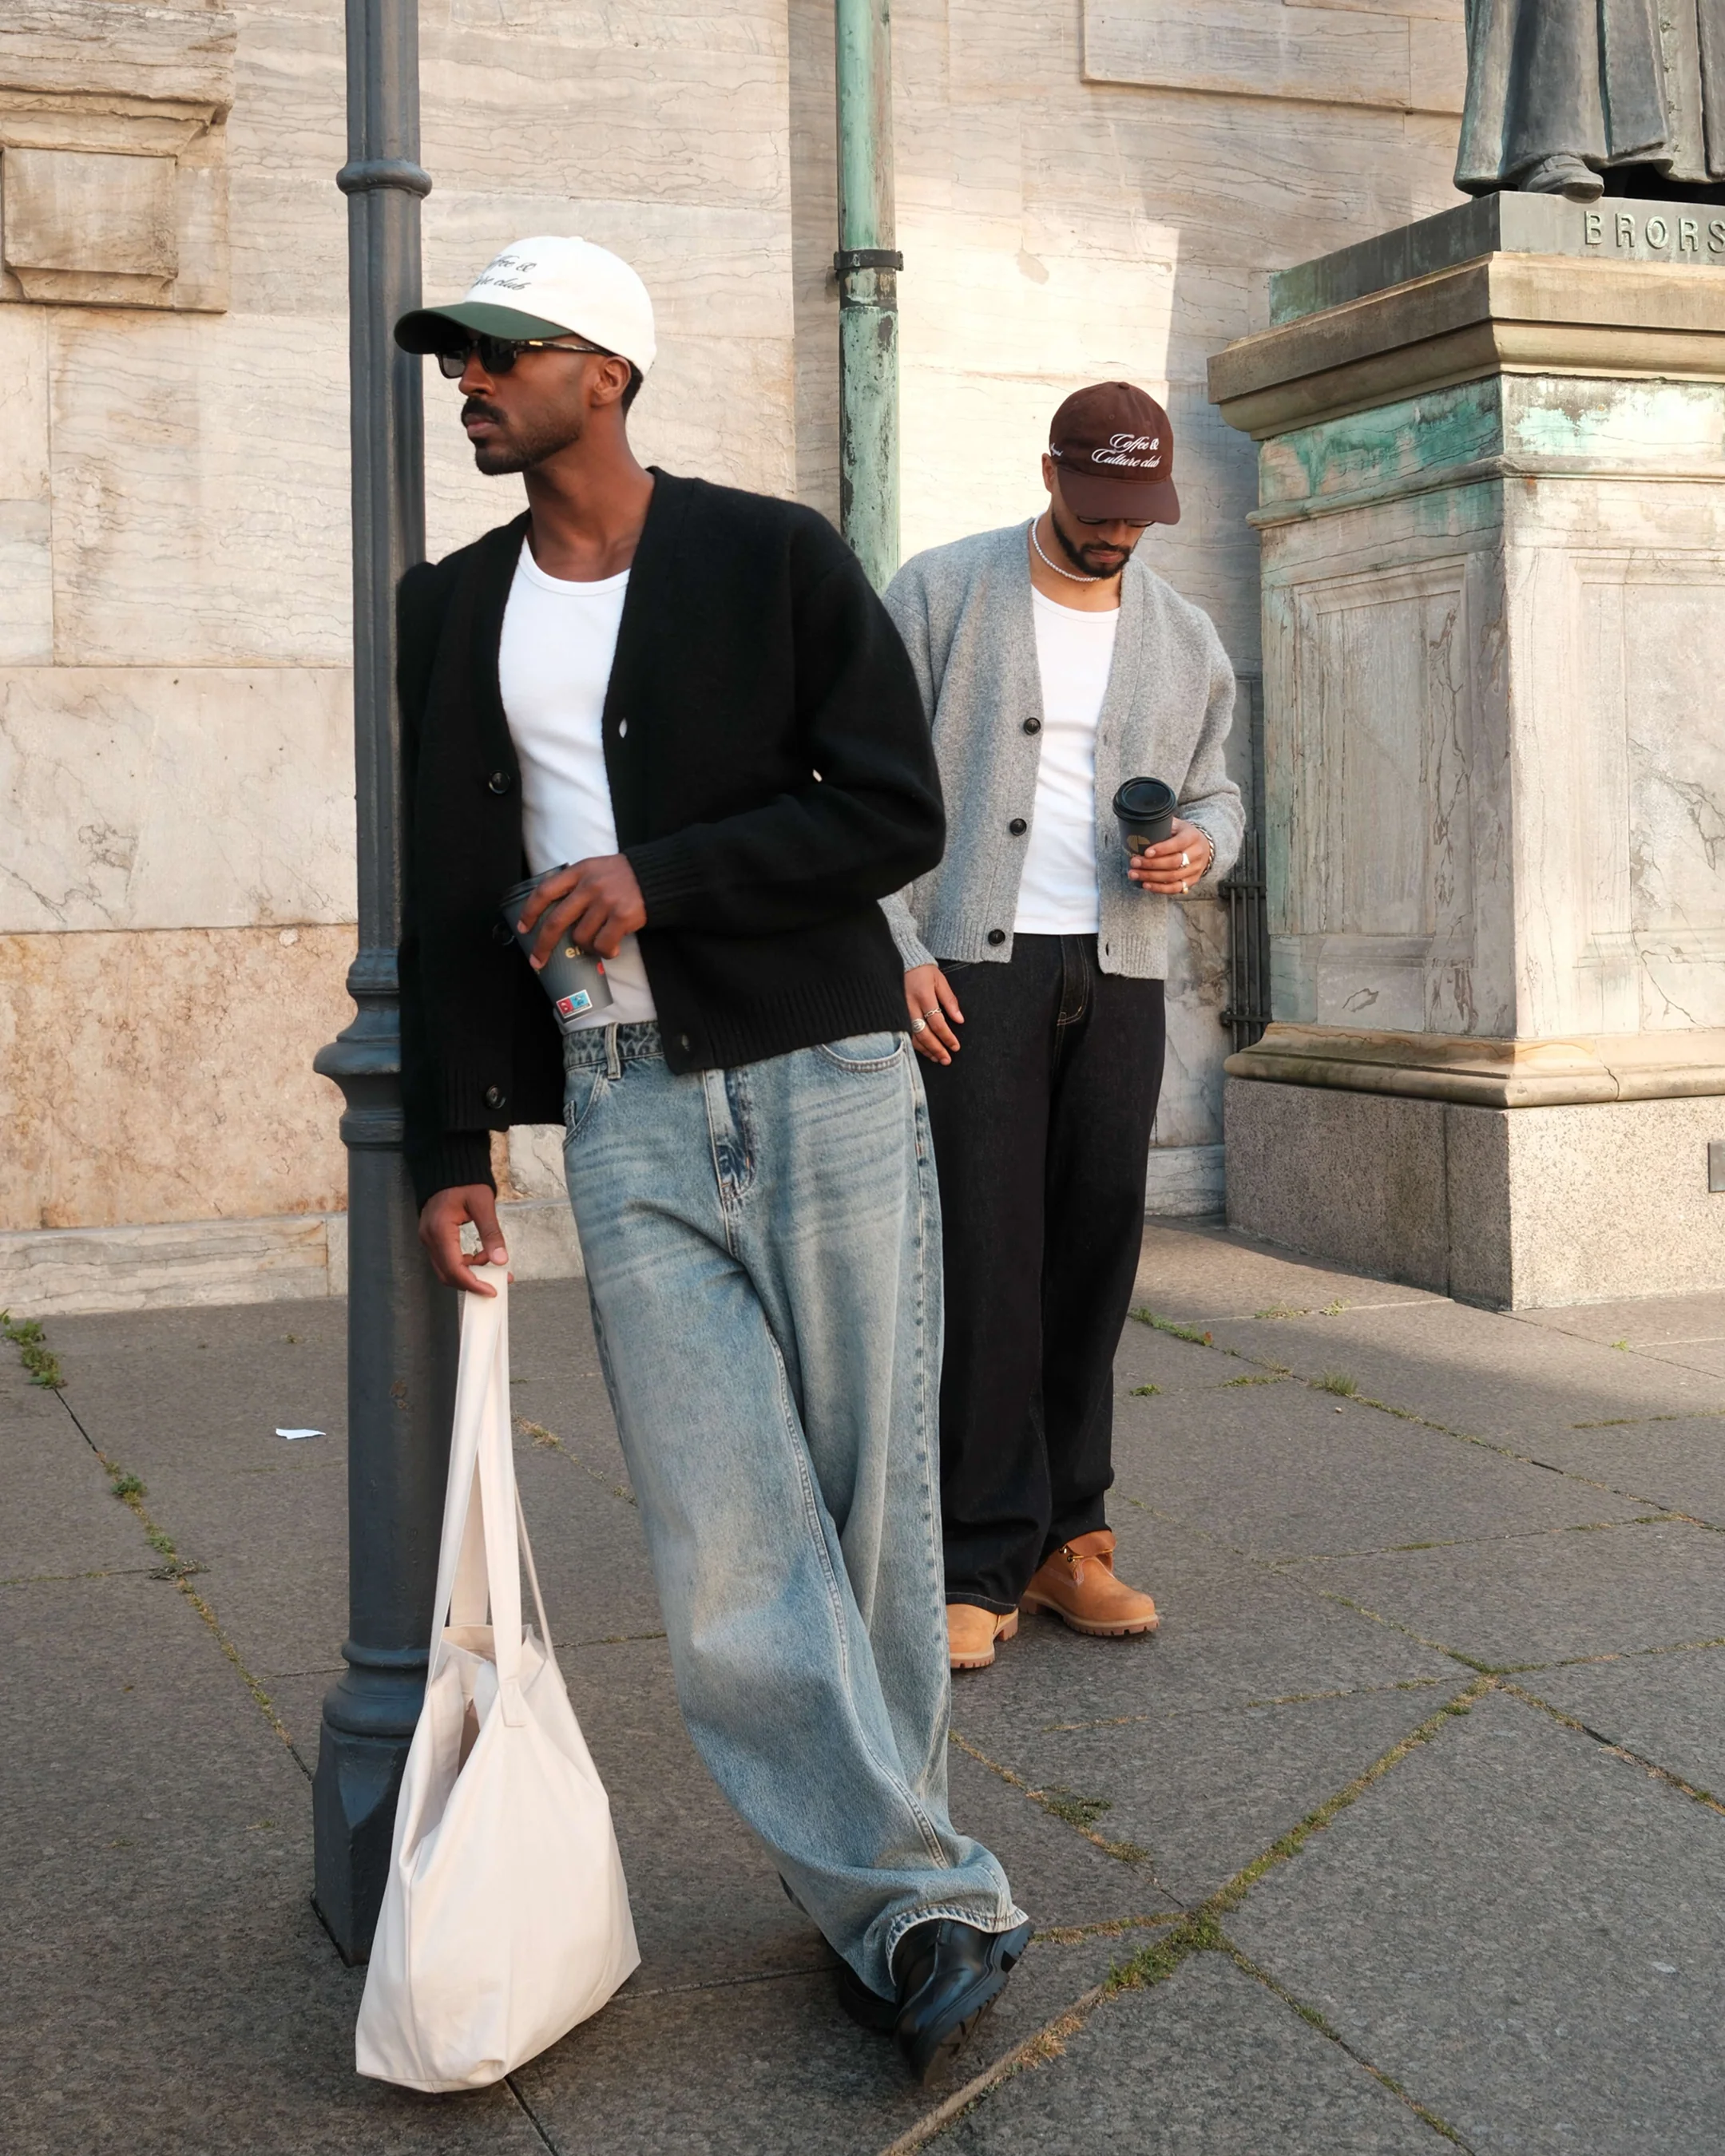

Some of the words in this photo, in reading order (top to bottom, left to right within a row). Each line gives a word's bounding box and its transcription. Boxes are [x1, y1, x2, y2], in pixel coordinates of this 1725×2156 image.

[1584, 210, 1725, 253] BRORS
[516, 262, 537, 272] &
[494, 277, 532, 291] club
[1109, 433, 1150, 454] Coffee
[1149, 437, 1160, 450] &
[1091, 448, 1142, 468] Culture
[1140, 454, 1162, 468] club
